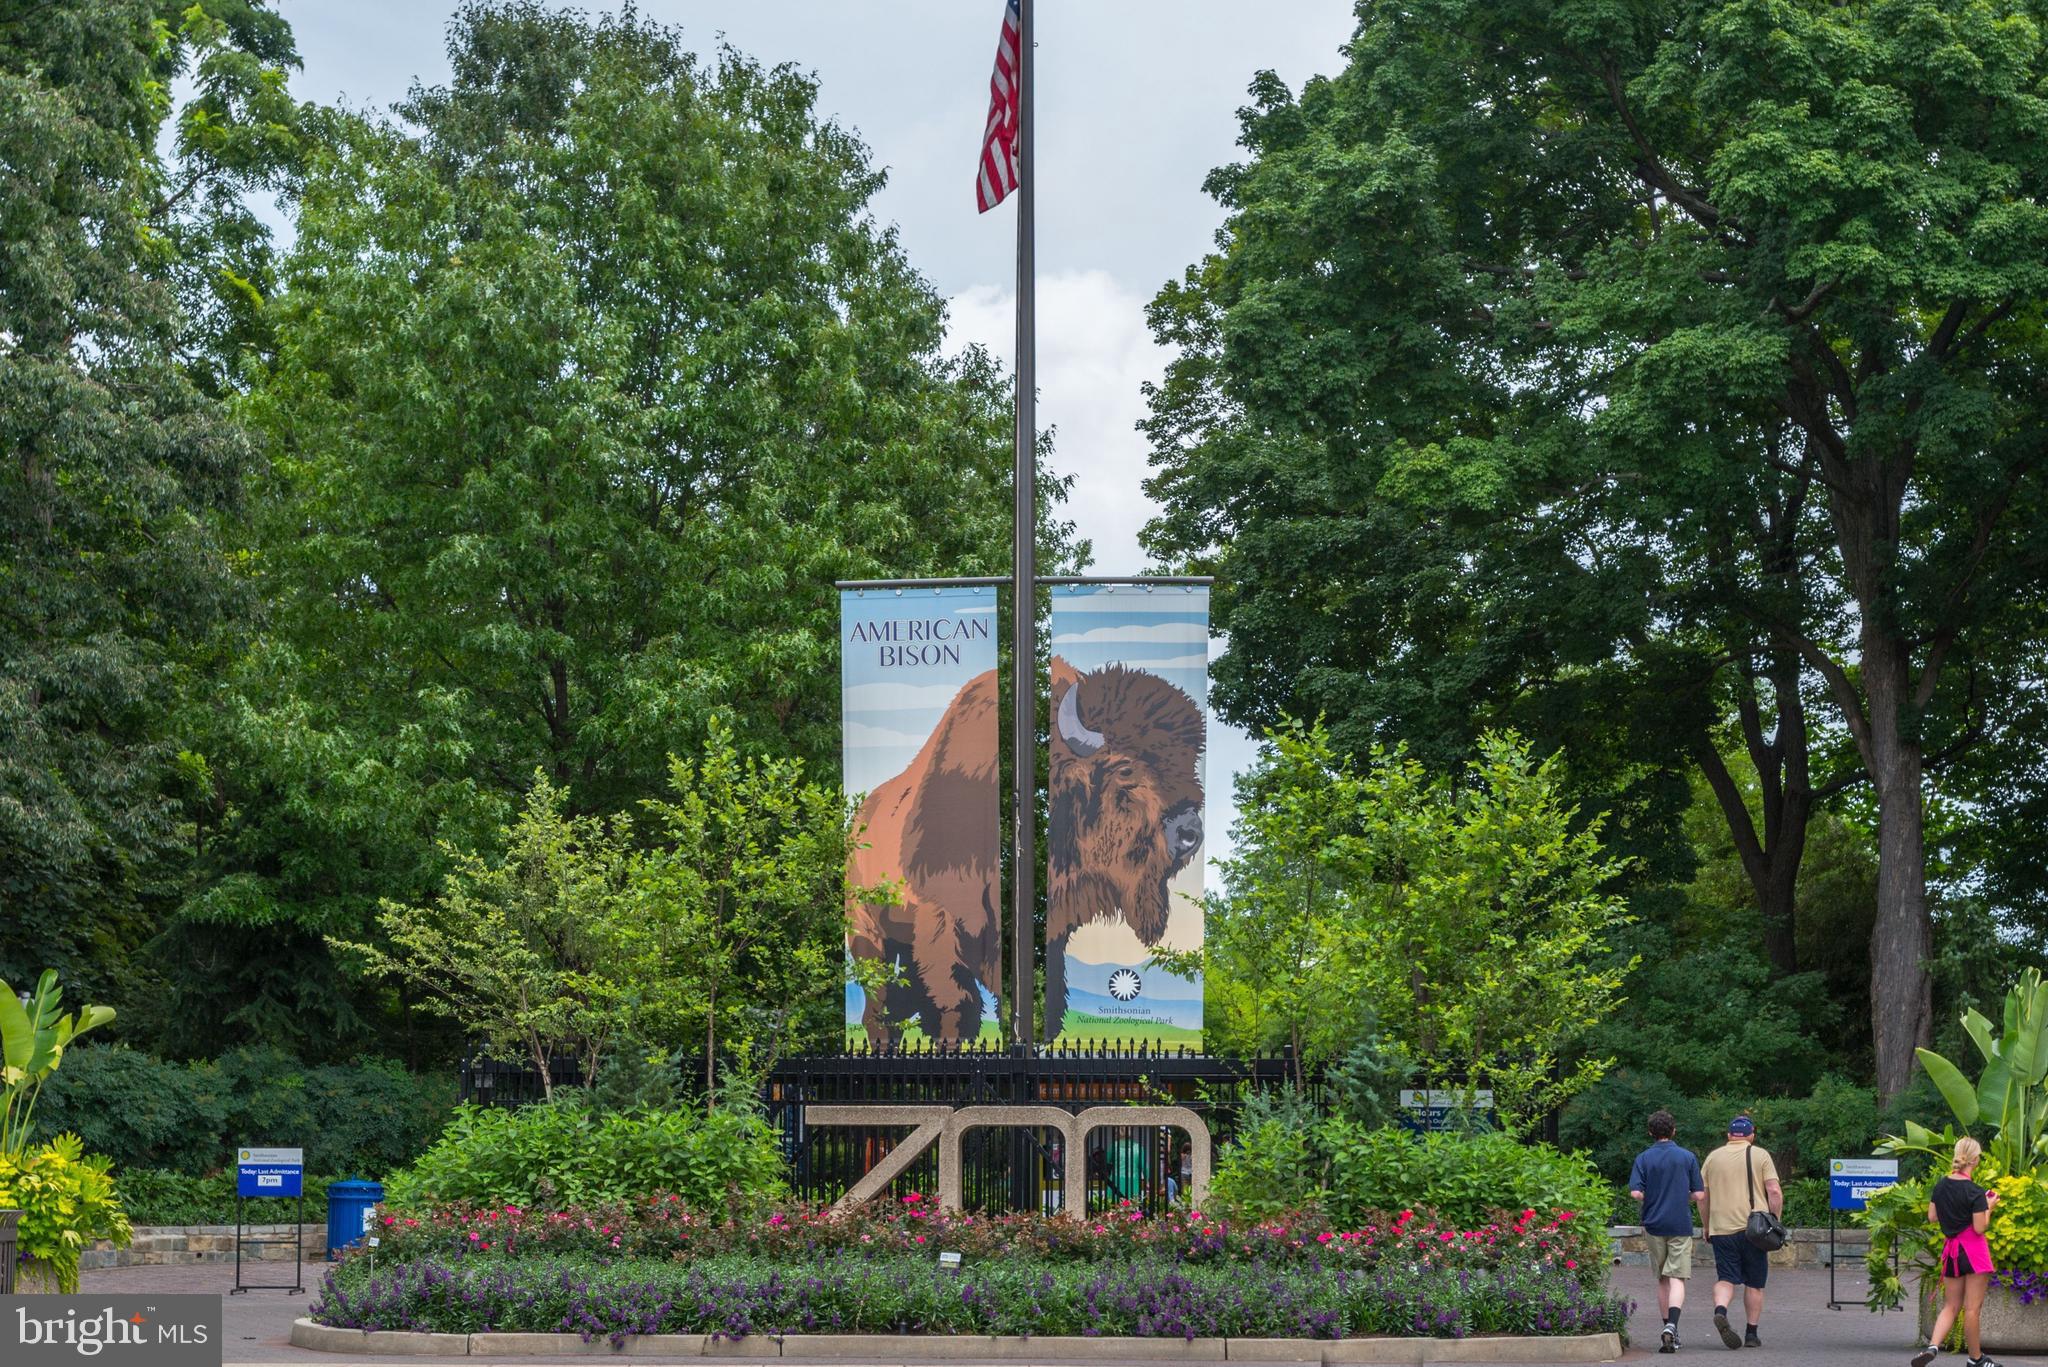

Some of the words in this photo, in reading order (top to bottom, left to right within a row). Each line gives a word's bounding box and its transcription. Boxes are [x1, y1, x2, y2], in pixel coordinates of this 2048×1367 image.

[850, 618, 988, 642] AMERICAN
[880, 644, 960, 666] BISON
[1077, 1011, 1111, 1025] National
[1113, 1011, 1154, 1027] Zoological
[1155, 1012, 1174, 1025] Park
[1098, 1004, 1151, 1015] Smithsonian
